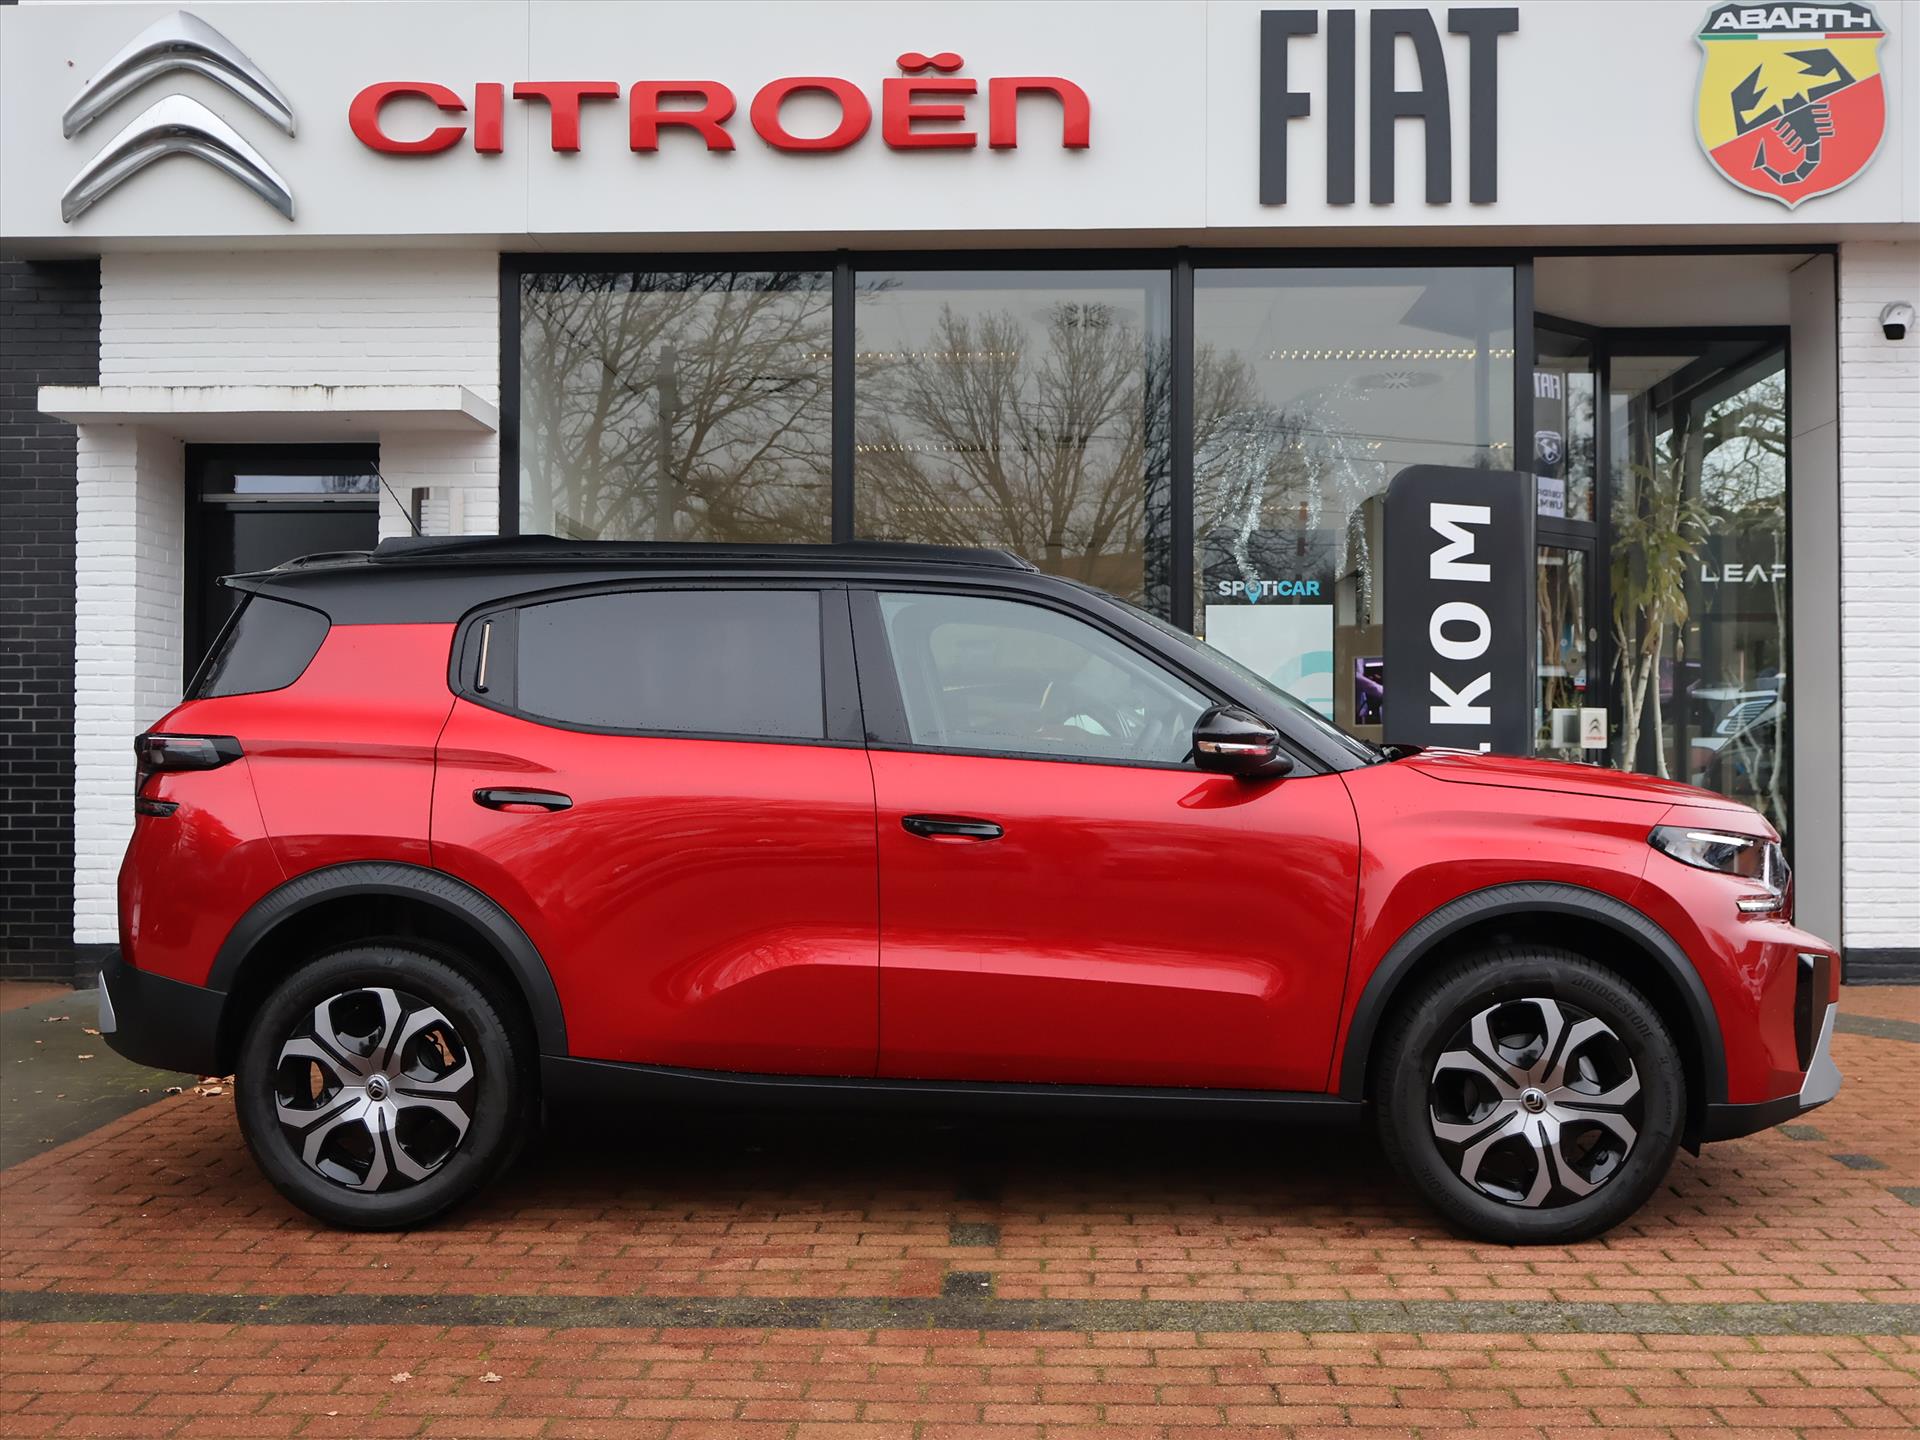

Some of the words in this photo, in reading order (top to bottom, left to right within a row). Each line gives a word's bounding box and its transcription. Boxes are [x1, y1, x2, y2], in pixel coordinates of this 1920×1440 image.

[1259, 8, 1519, 205] FIAT
[1711, 7, 1872, 30] ABARTH
[1429, 502, 1491, 752] KOM
